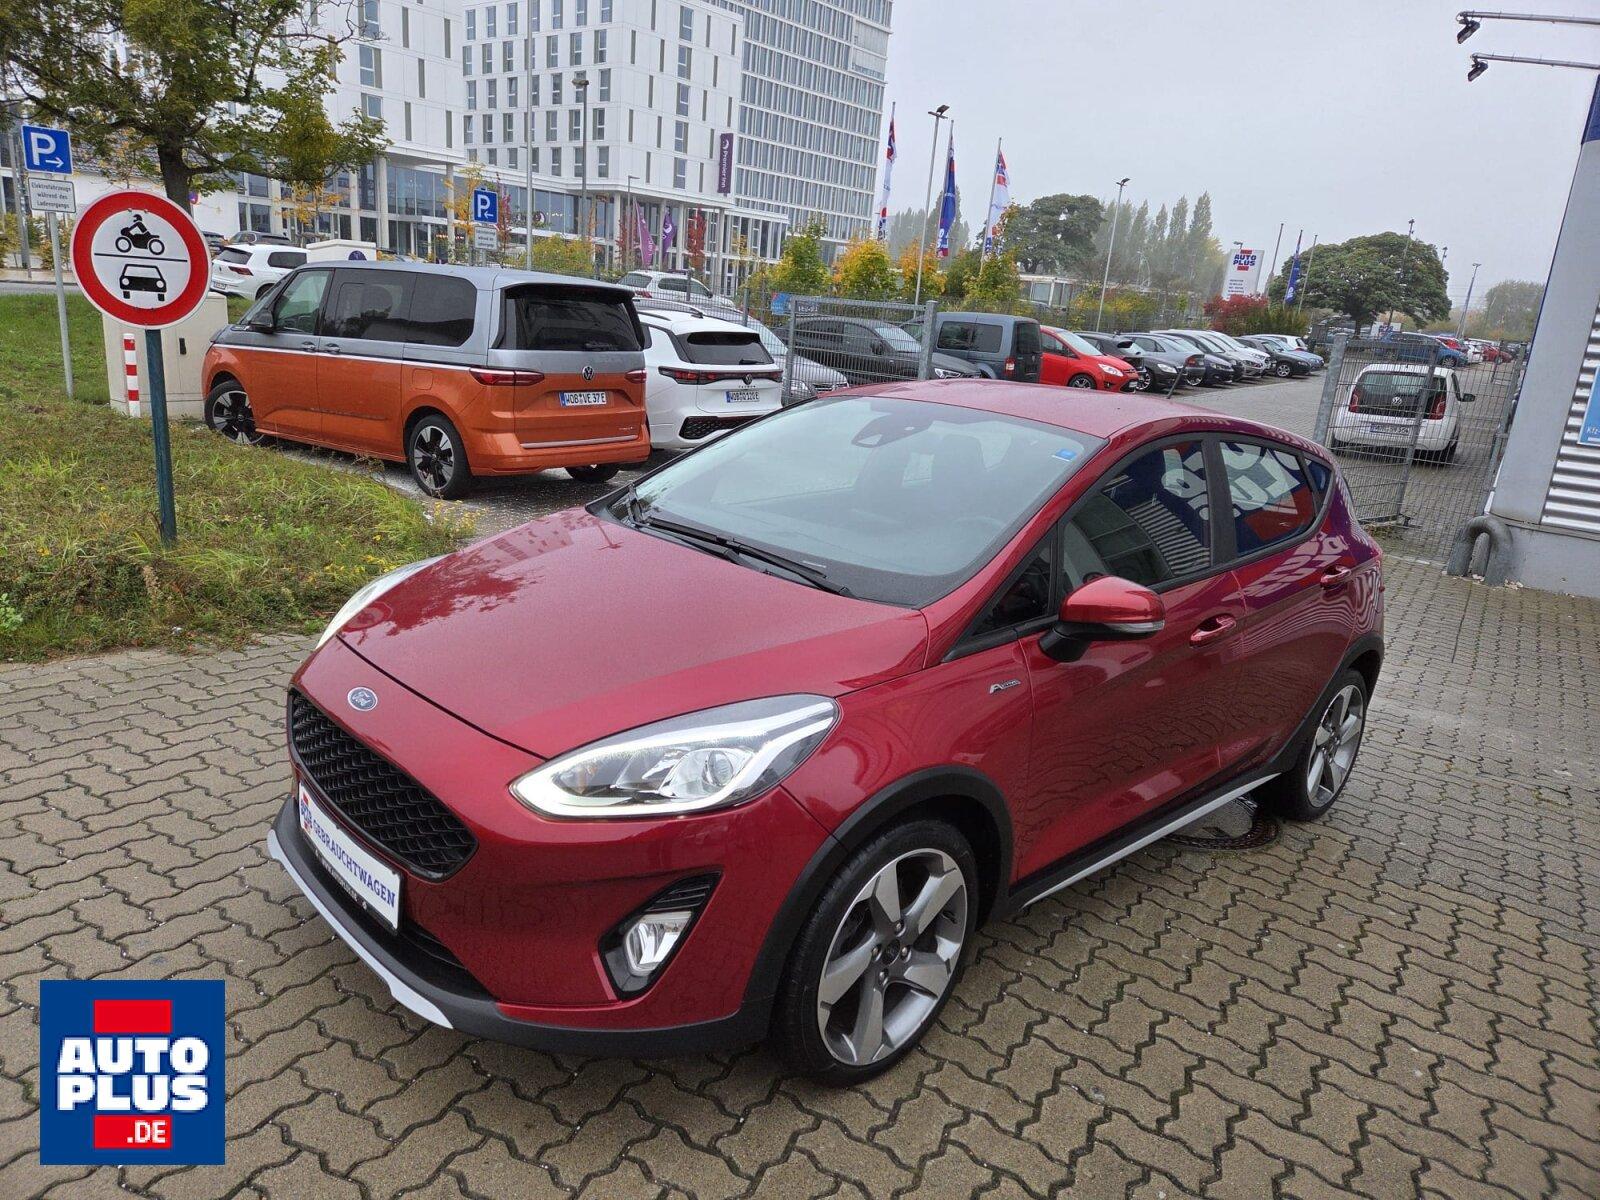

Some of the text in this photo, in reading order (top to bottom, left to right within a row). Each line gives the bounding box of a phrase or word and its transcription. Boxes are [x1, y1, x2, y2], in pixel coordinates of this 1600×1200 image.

[31, 132, 56, 165] P
[477, 194, 490, 218] P
[313, 819, 396, 908] GEBRAUCHTWAGEN
